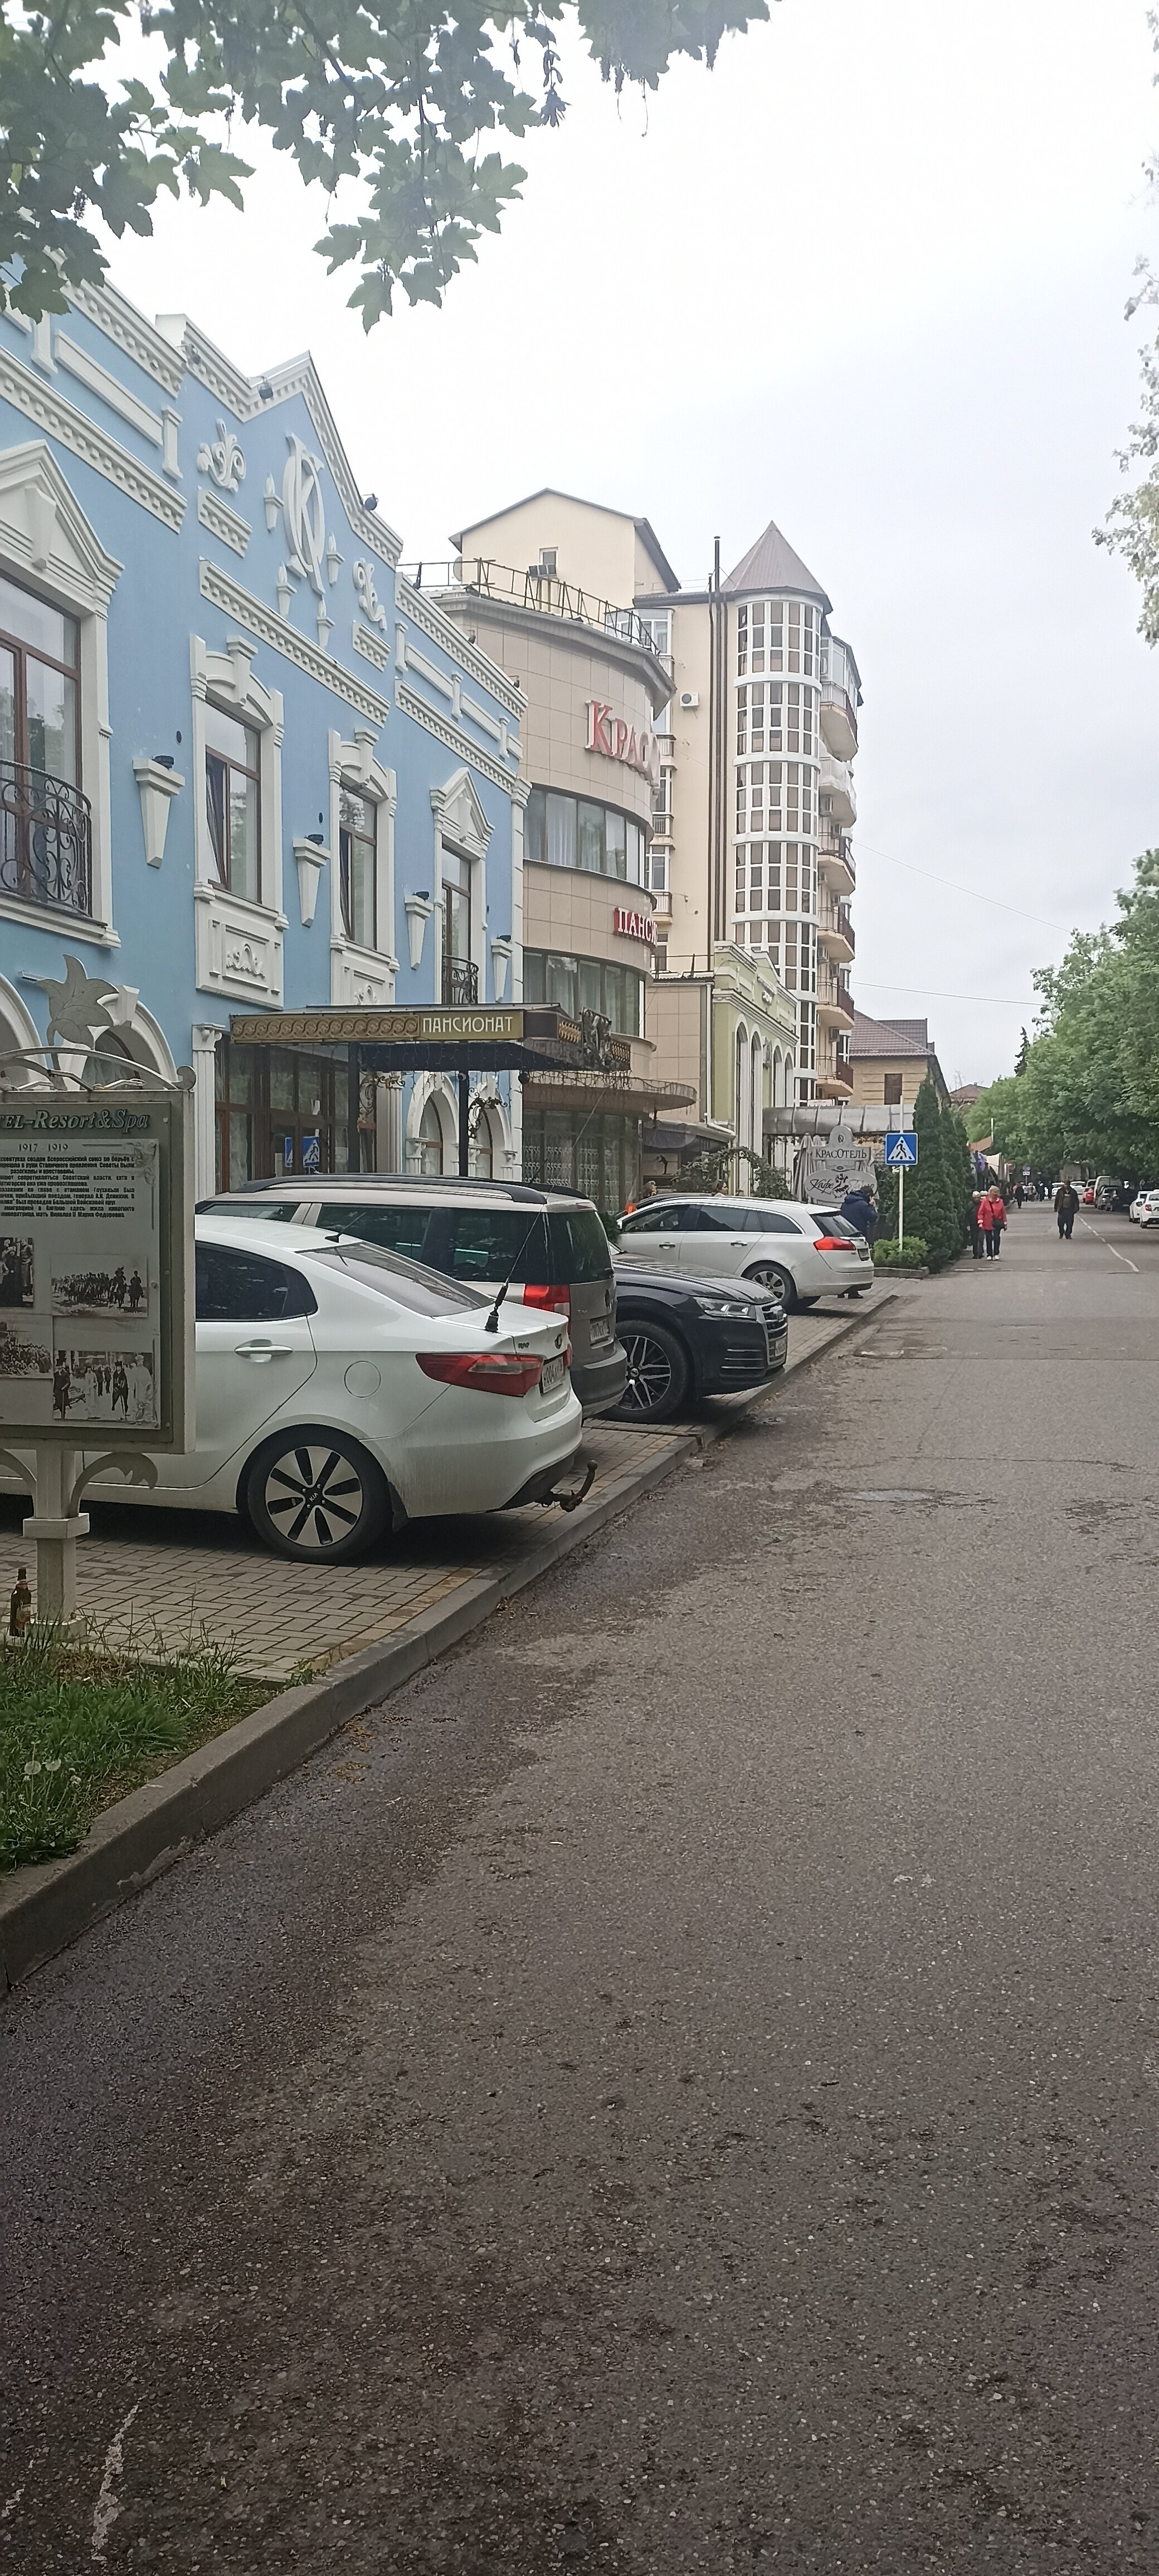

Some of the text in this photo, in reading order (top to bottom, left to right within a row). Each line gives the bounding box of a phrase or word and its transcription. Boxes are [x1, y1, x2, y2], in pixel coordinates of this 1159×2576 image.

[423, 1017, 513, 1033] ПАНСИОНАТ
[18, 1144, 38, 1152] 1917
[48, 1144, 69, 1152] 1919
[808, 1179, 834, 1194] Кафе
